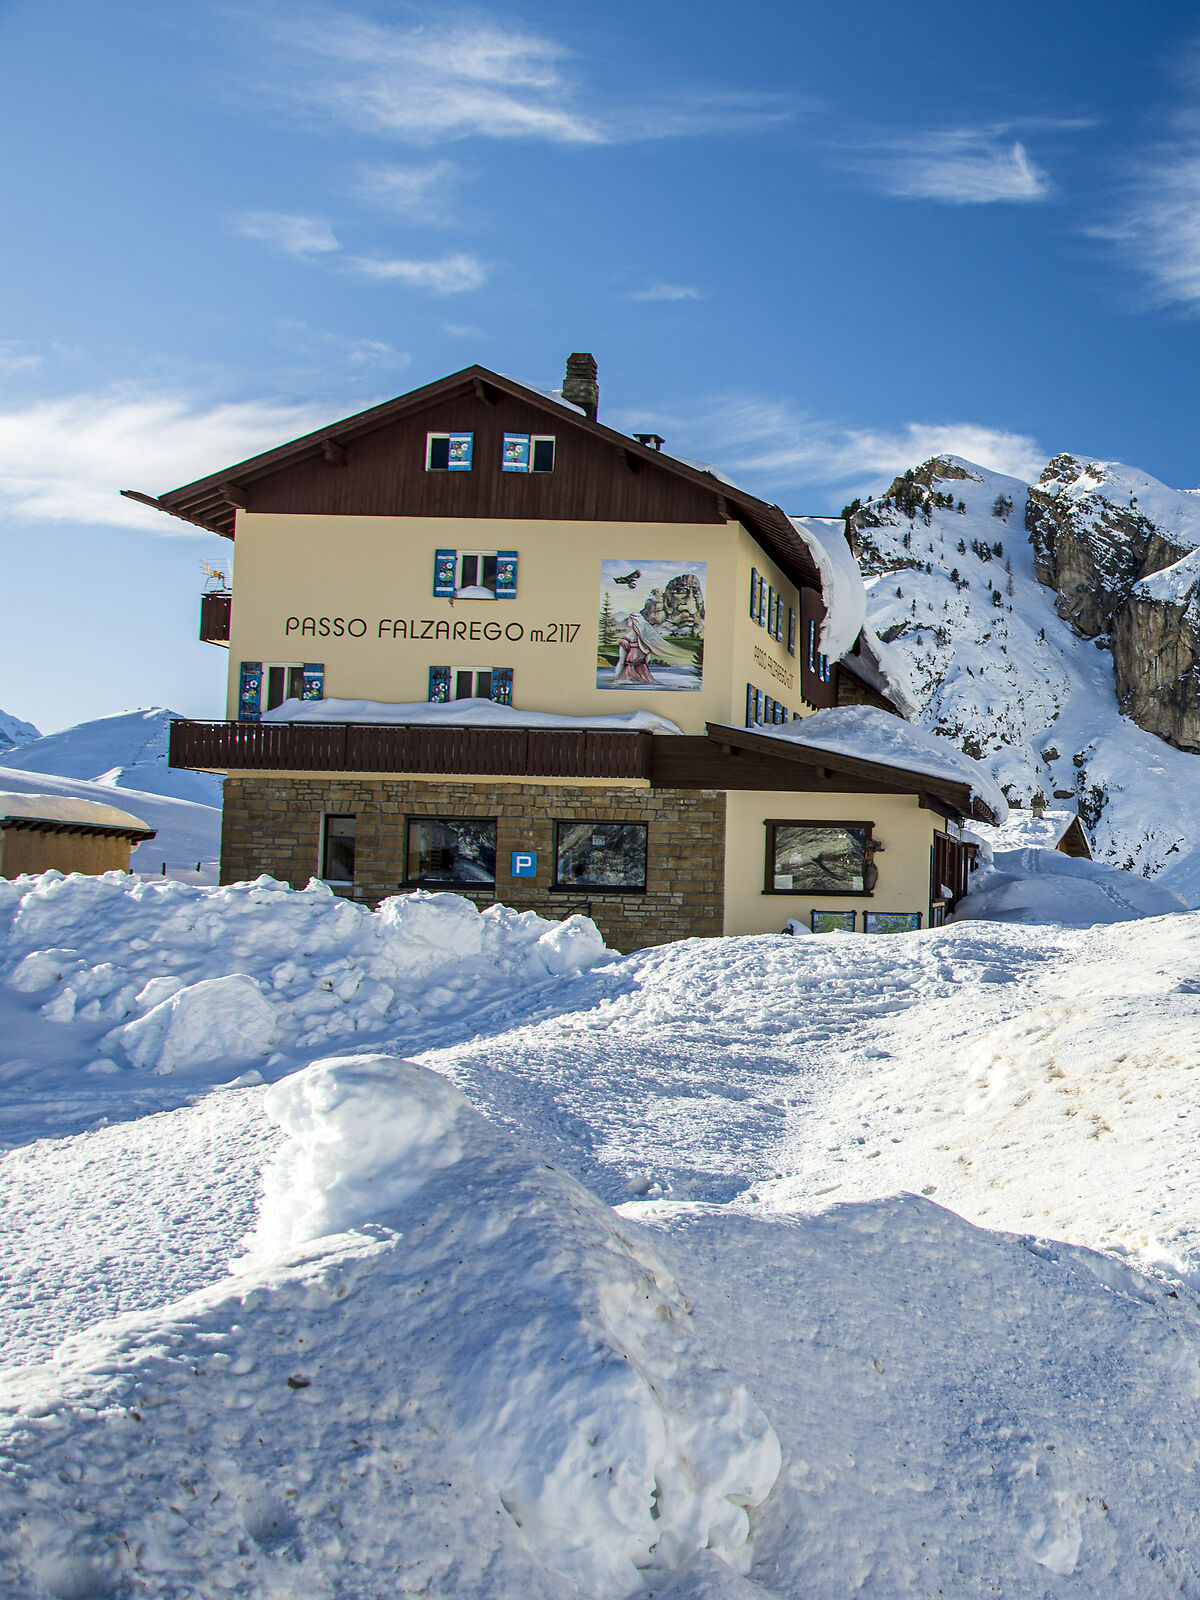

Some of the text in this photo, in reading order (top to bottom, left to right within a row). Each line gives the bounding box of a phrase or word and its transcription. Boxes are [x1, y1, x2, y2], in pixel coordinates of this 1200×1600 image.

[285, 616, 581, 643] PASSO FALZAREGO m.2117
[516, 856, 532, 874] P
